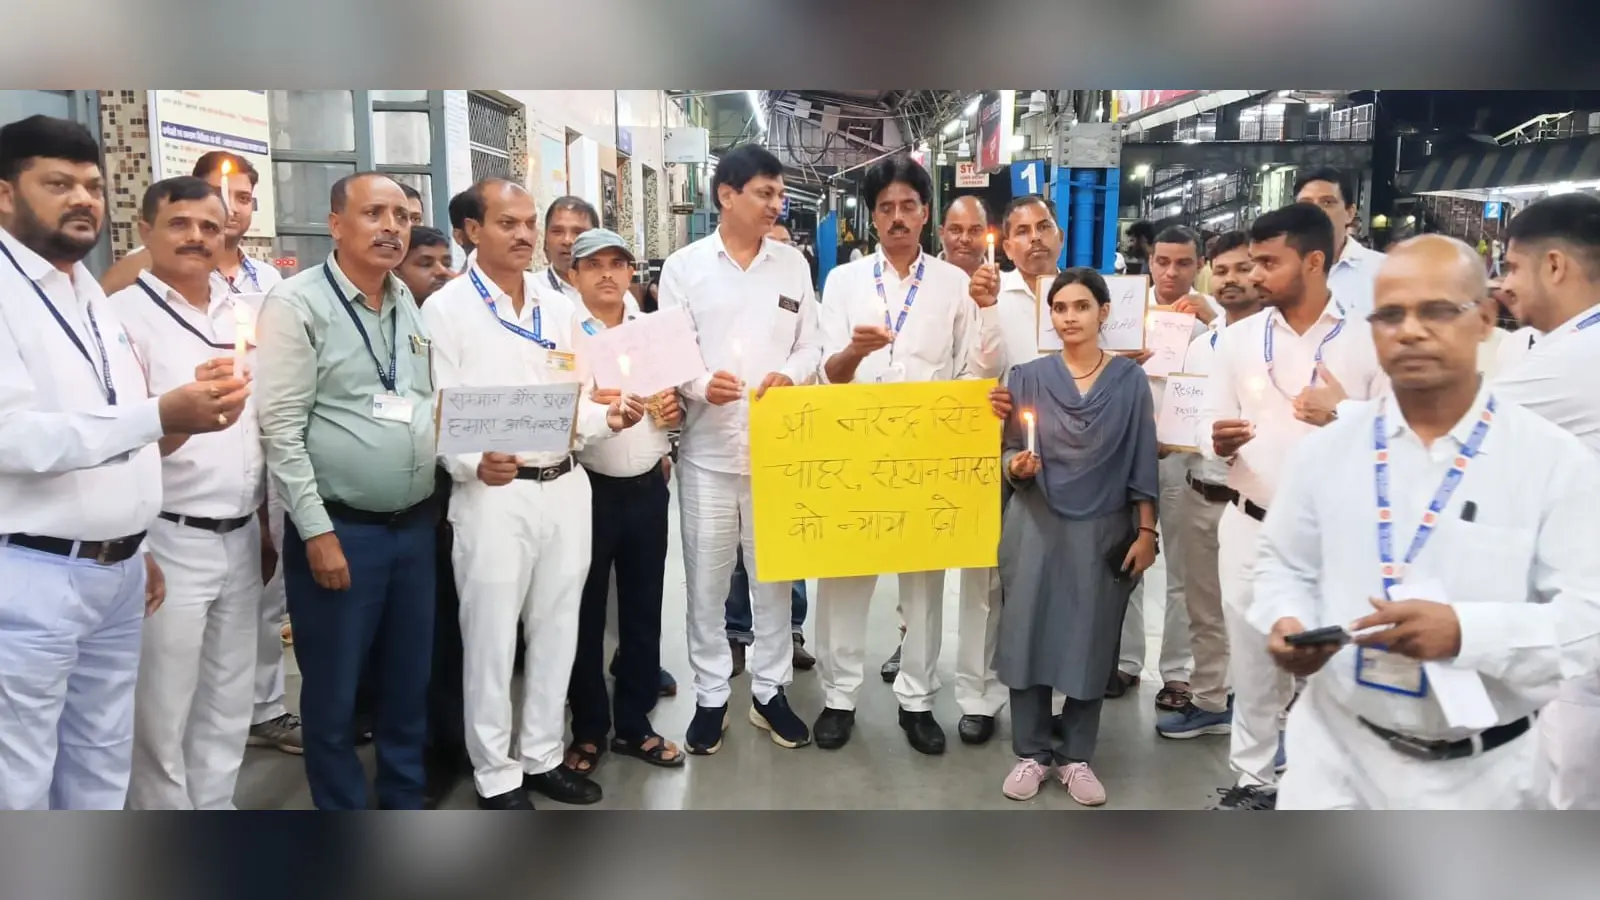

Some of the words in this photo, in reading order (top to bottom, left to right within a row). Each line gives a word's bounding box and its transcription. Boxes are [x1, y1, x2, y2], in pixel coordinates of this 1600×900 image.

[1020, 163, 1038, 194] 1
[1487, 202, 1499, 218] 2
[775, 402, 821, 442] श्री
[788, 502, 829, 543] को
